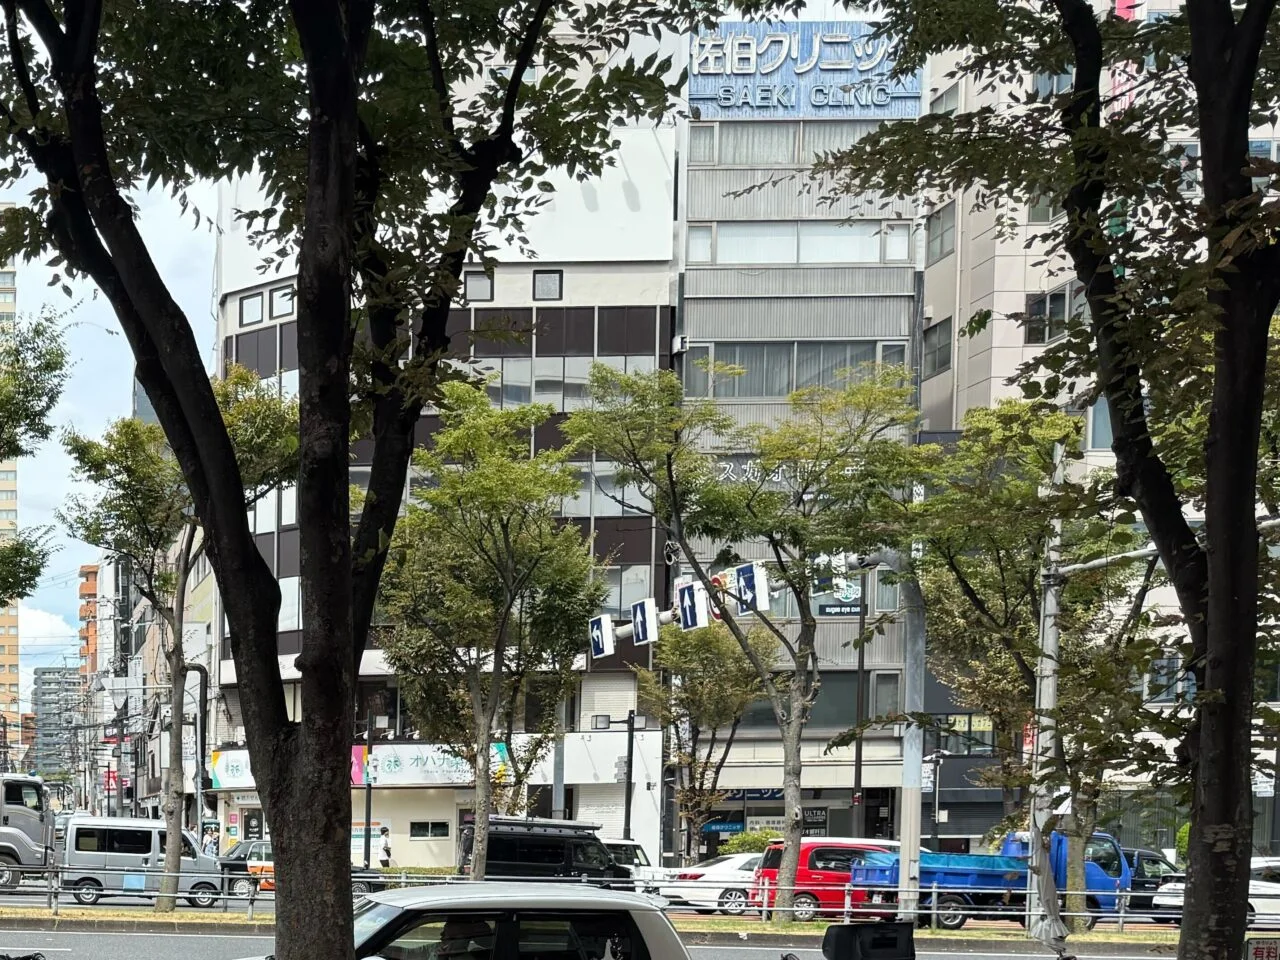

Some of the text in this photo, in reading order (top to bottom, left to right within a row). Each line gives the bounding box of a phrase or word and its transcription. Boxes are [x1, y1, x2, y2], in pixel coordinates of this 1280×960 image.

[690, 31, 902, 75] 佐伯クリニッ
[718, 84, 891, 107] SAEKI CLINIC
[1252, 946, 1278, 960] 有料
